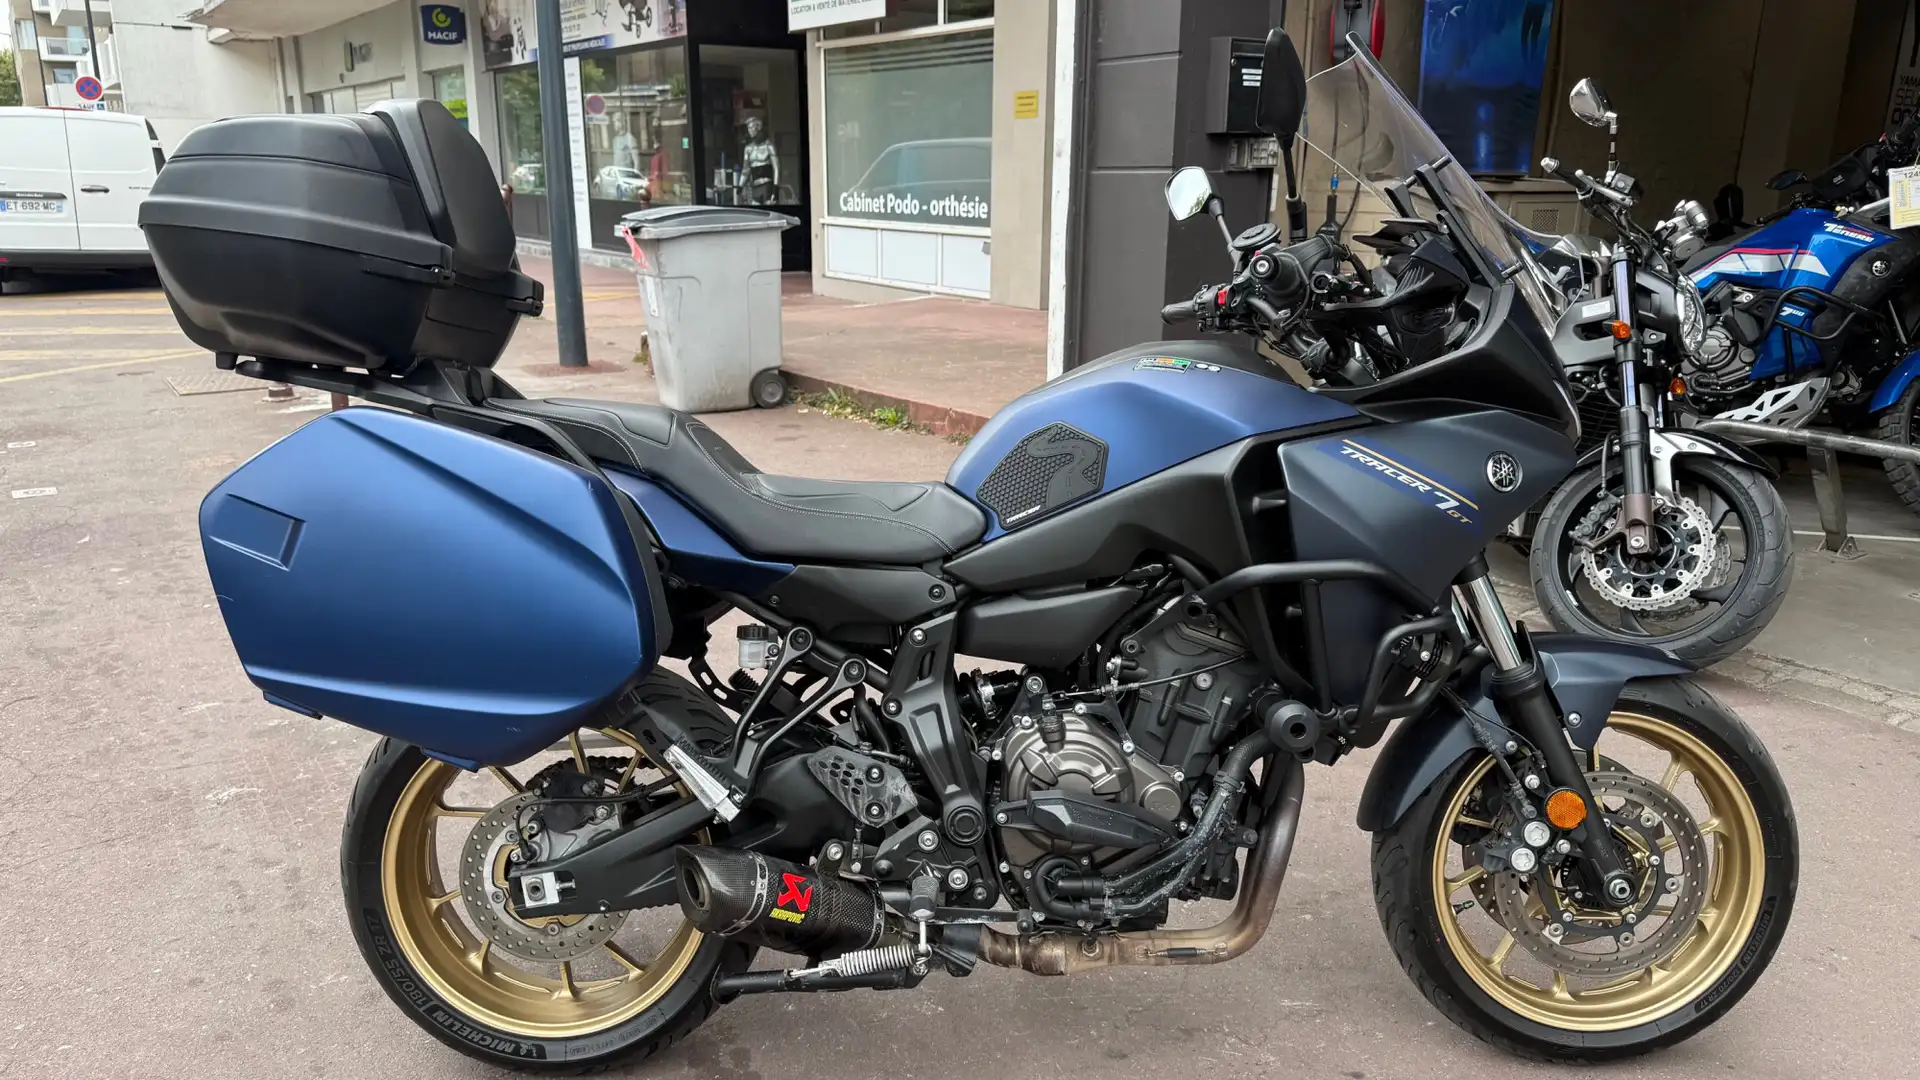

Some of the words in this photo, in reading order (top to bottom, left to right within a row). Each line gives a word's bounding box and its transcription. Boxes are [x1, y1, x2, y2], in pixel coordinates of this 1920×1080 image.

[427, 31, 458, 40] MACIF
[839, 191, 885, 214] Cabinet
[887, 193, 919, 215] Podo
[930, 194, 988, 219] orthésie
[1780, 306, 1805, 317] 700
[1340, 445, 1433, 493] TRACER
[1434, 491, 1460, 510] 7
[1446, 509, 1473, 524] GT
[1744, 912, 1770, 963] MICHELIN
[385, 959, 429, 1007] 180/55
[432, 1010, 516, 1054] MICHELIN
